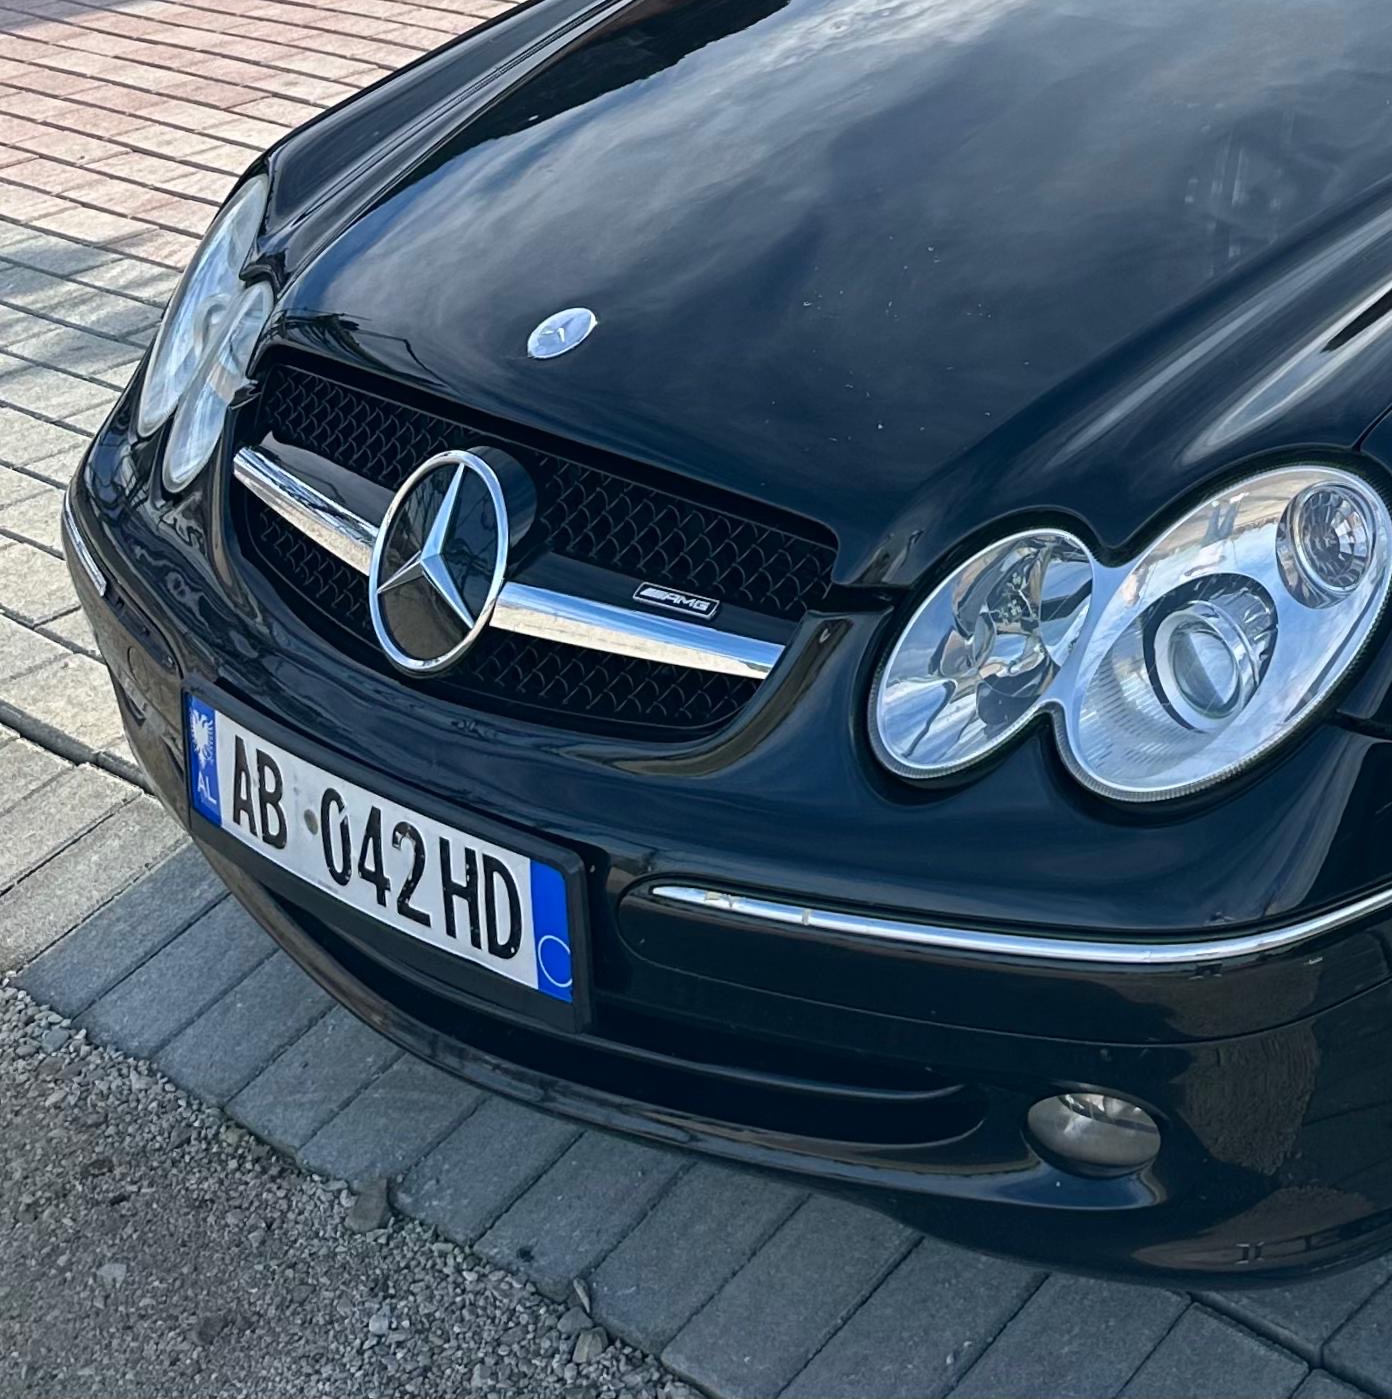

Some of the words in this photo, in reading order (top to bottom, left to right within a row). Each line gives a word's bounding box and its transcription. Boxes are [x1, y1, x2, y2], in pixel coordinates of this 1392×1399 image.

[655, 591, 710, 611] AMG
[197, 769, 217, 805] AL
[233, 734, 287, 850] AB
